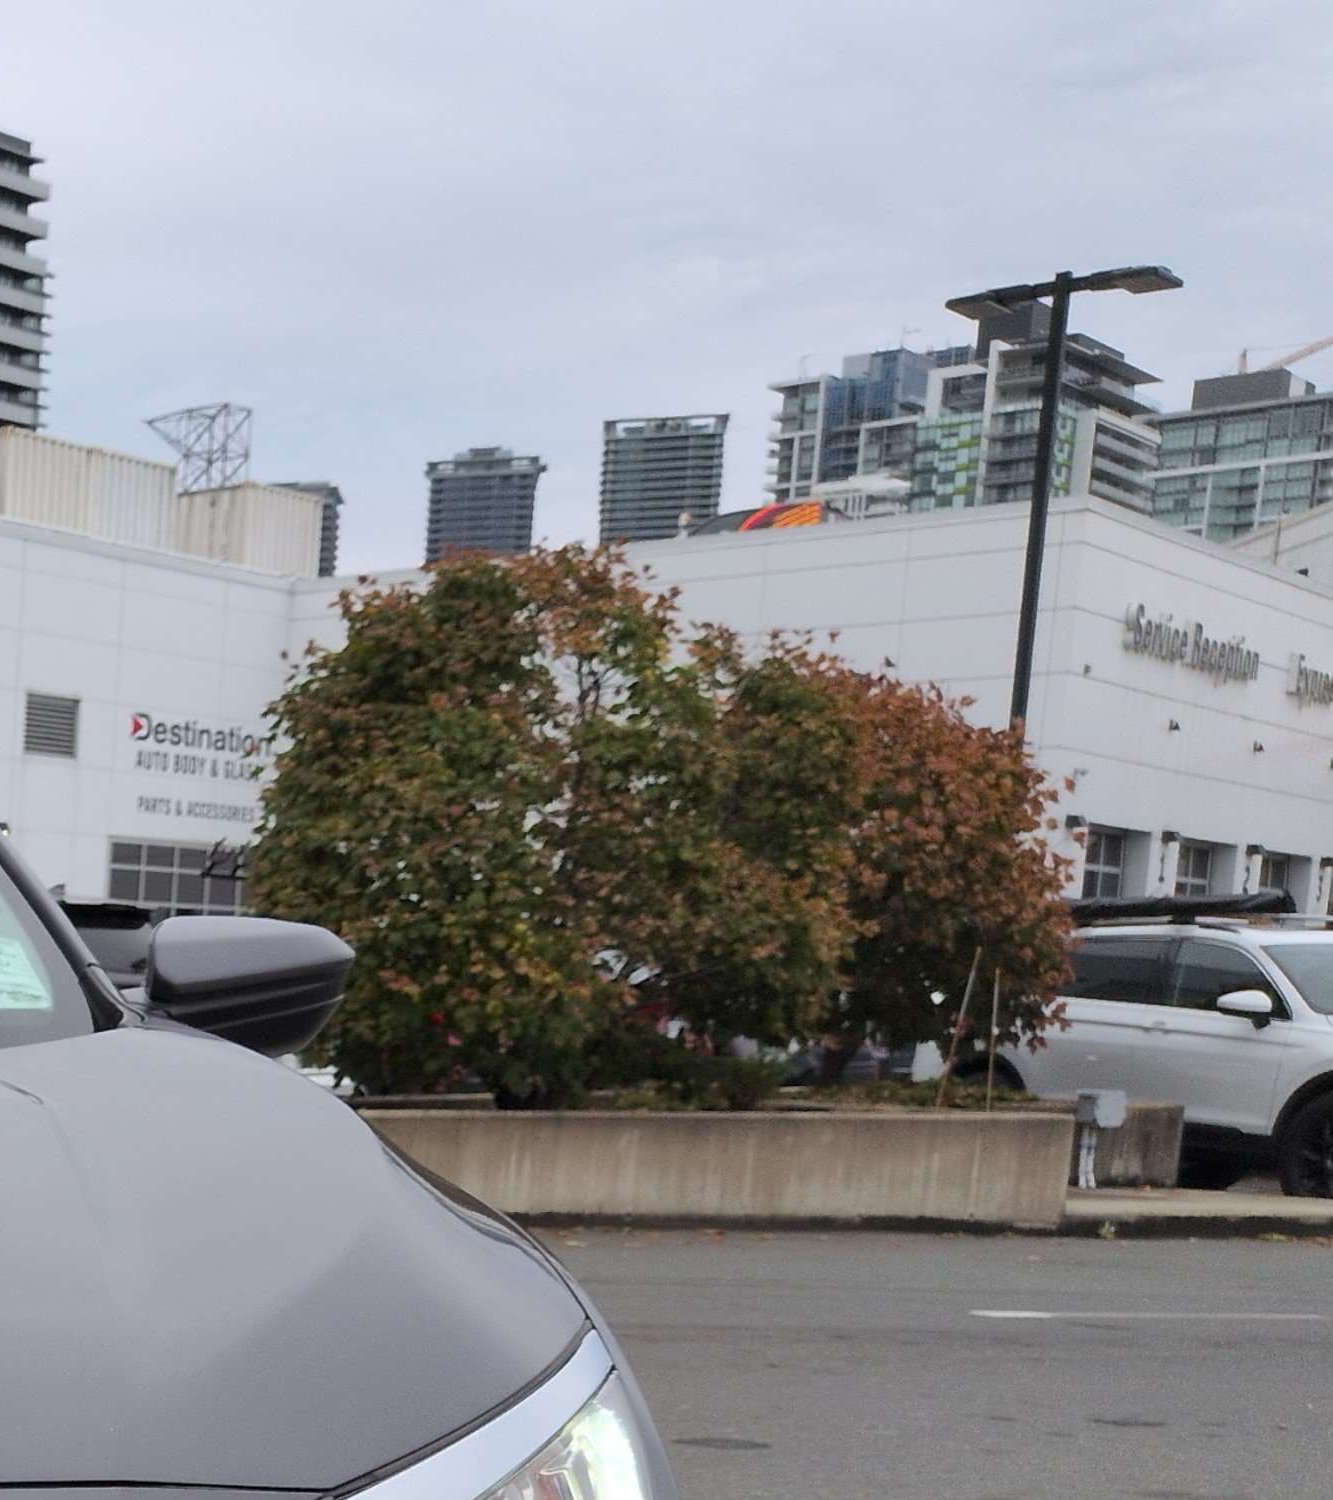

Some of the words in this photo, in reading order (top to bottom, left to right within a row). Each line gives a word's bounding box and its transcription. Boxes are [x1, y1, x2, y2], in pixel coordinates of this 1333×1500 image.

[1126, 602, 1189, 663] Service
[1190, 621, 1260, 687] Reception
[131, 712, 272, 757] Destination
[135, 750, 171, 773] AUTO
[173, 753, 208, 776] BODY
[210, 759, 219, 778] &
[137, 796, 172, 816] PARTS
[175, 798, 183, 817] &
[186, 801, 256, 824] ACCESSORIES
